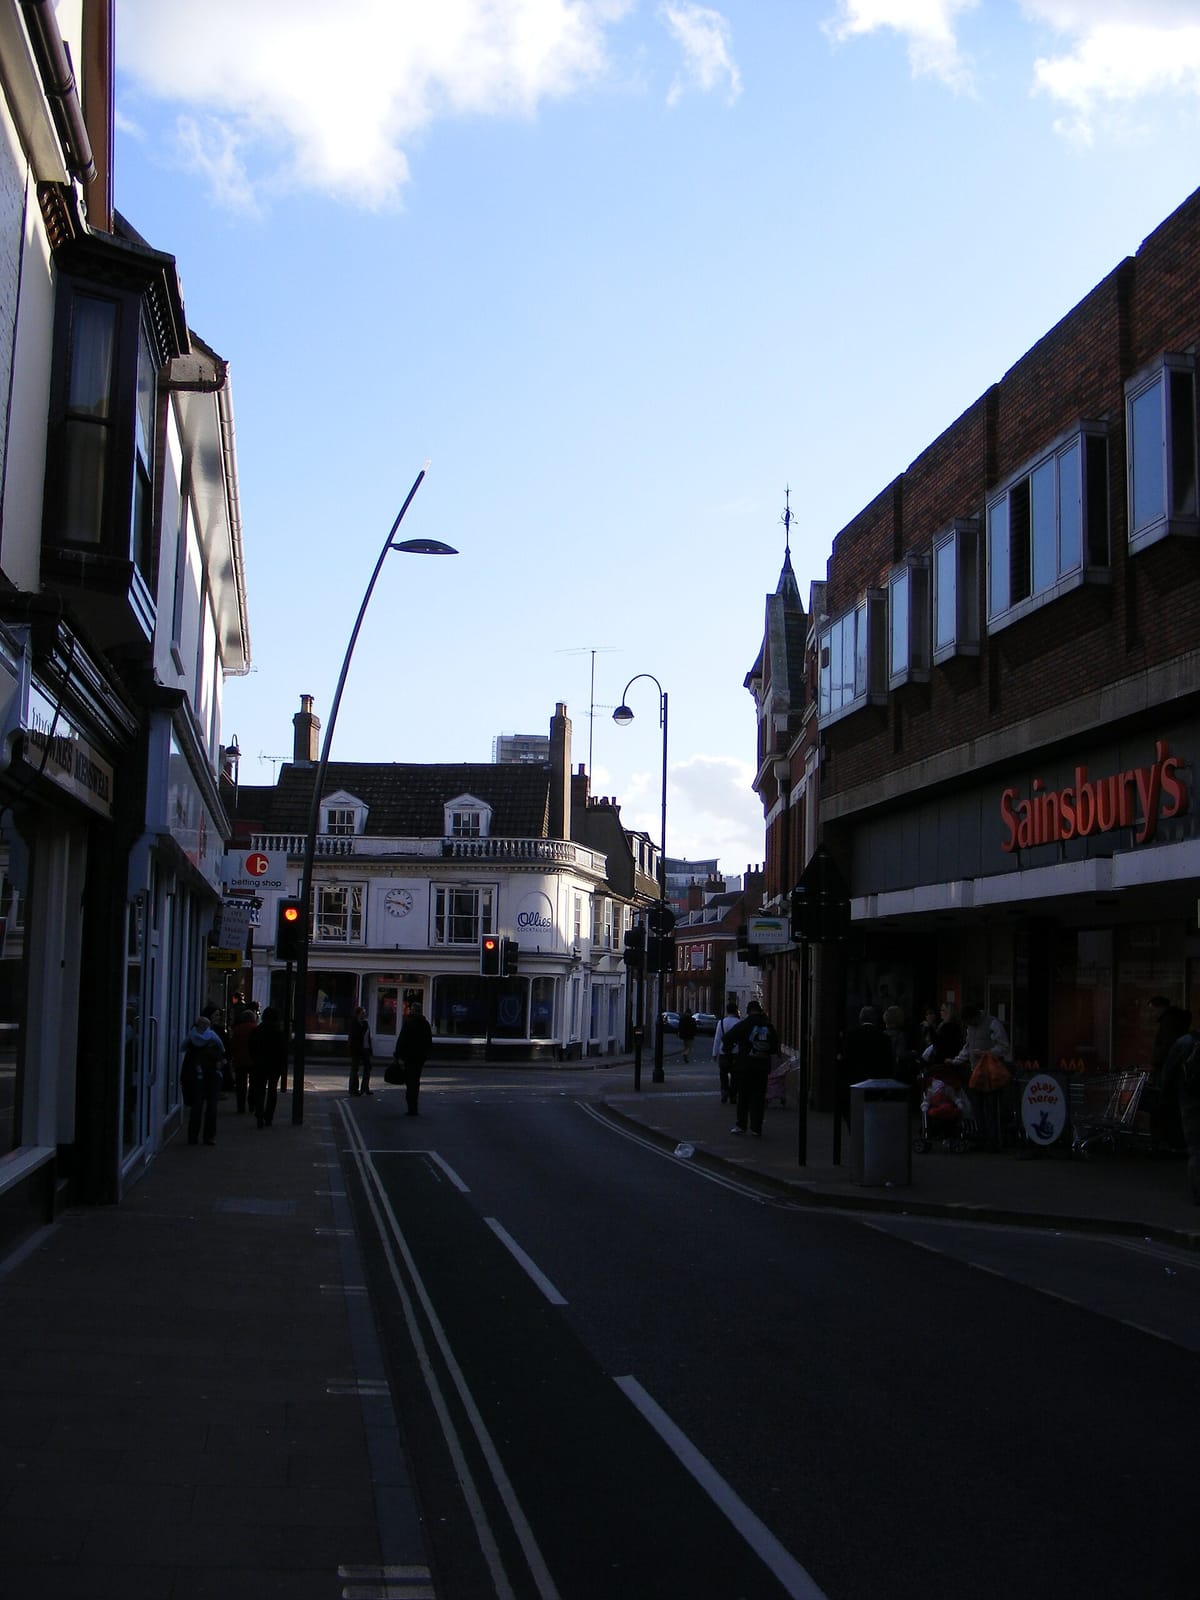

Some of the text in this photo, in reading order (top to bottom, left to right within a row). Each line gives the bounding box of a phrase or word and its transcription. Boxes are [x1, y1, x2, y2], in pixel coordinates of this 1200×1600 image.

[1000, 739, 1189, 853] Sainsbury's
[231, 878, 282, 888] betting shop
[517, 911, 551, 927] Ollies
